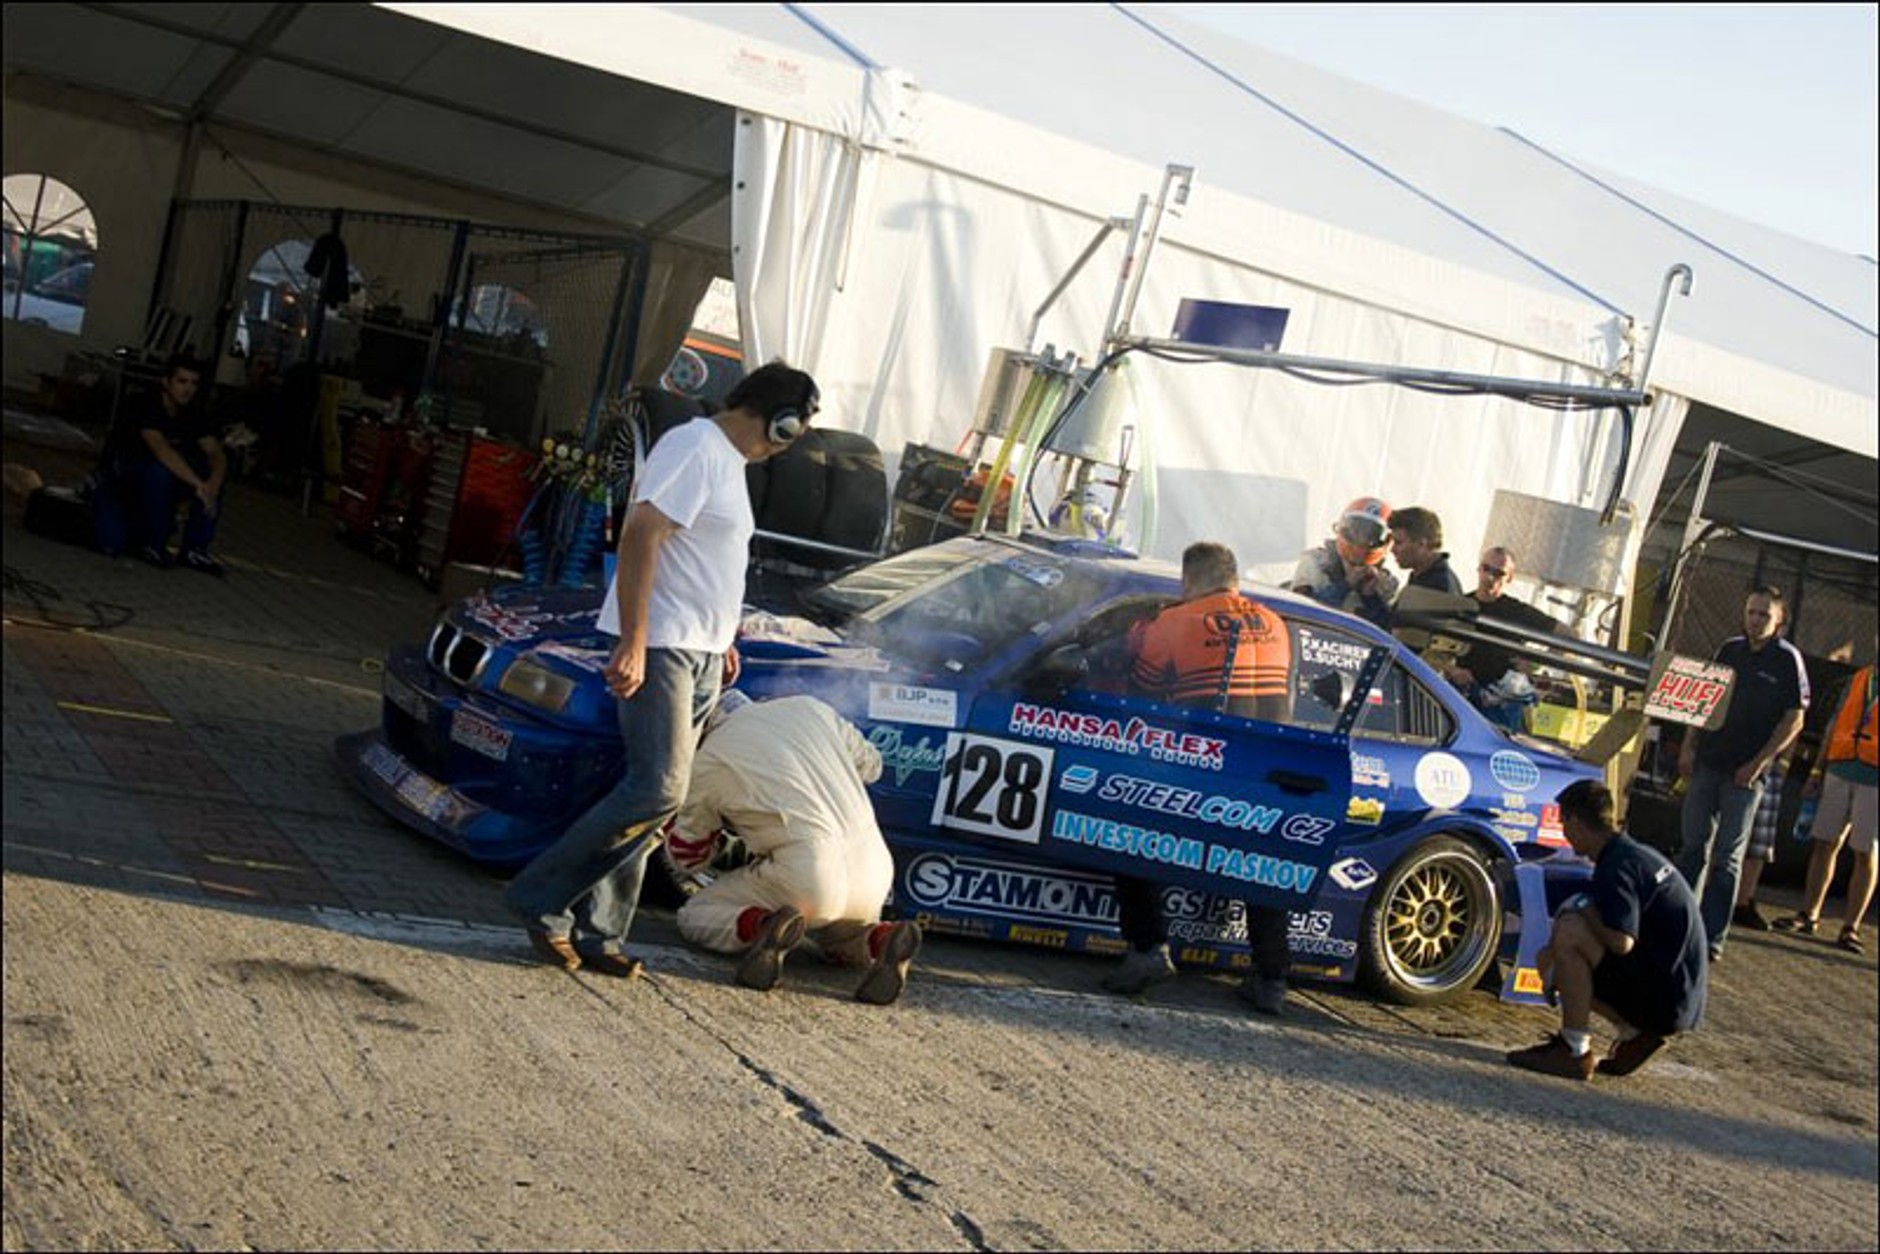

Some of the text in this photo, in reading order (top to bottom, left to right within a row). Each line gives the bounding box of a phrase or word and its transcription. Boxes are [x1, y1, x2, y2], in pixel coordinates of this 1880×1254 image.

[943, 737, 1044, 832] 128
[1098, 774, 1335, 845] STEELCOM CZ
[1052, 809, 1318, 894] INVESTCOM PASKOV
